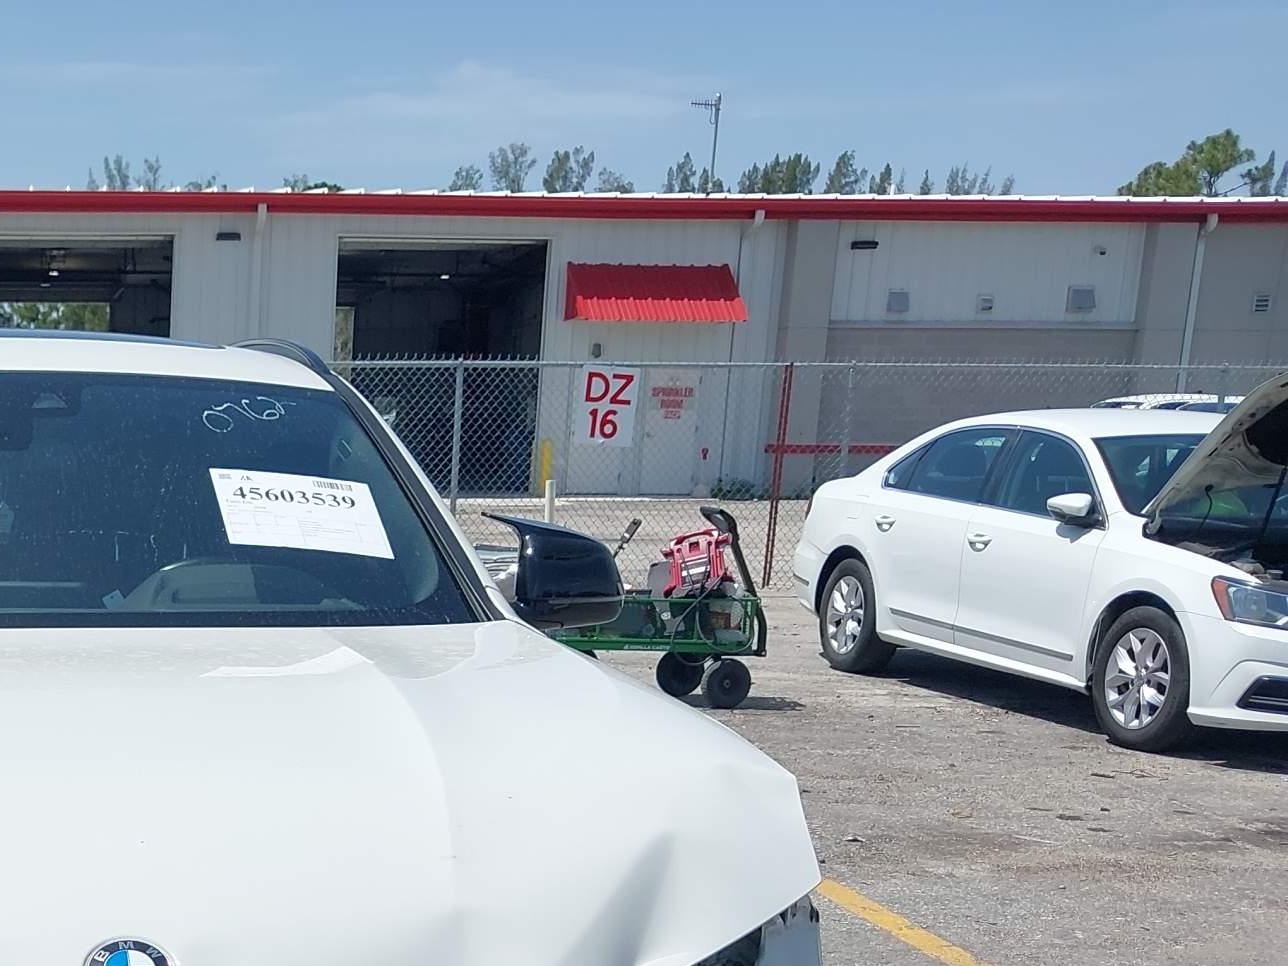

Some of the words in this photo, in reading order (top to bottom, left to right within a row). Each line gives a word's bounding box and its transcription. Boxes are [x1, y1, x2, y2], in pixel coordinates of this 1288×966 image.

[585, 371, 634, 405] DZ
[589, 408, 618, 439] 16
[232, 486, 356, 509] 45603539
[94, 941, 162, 962] BMW
